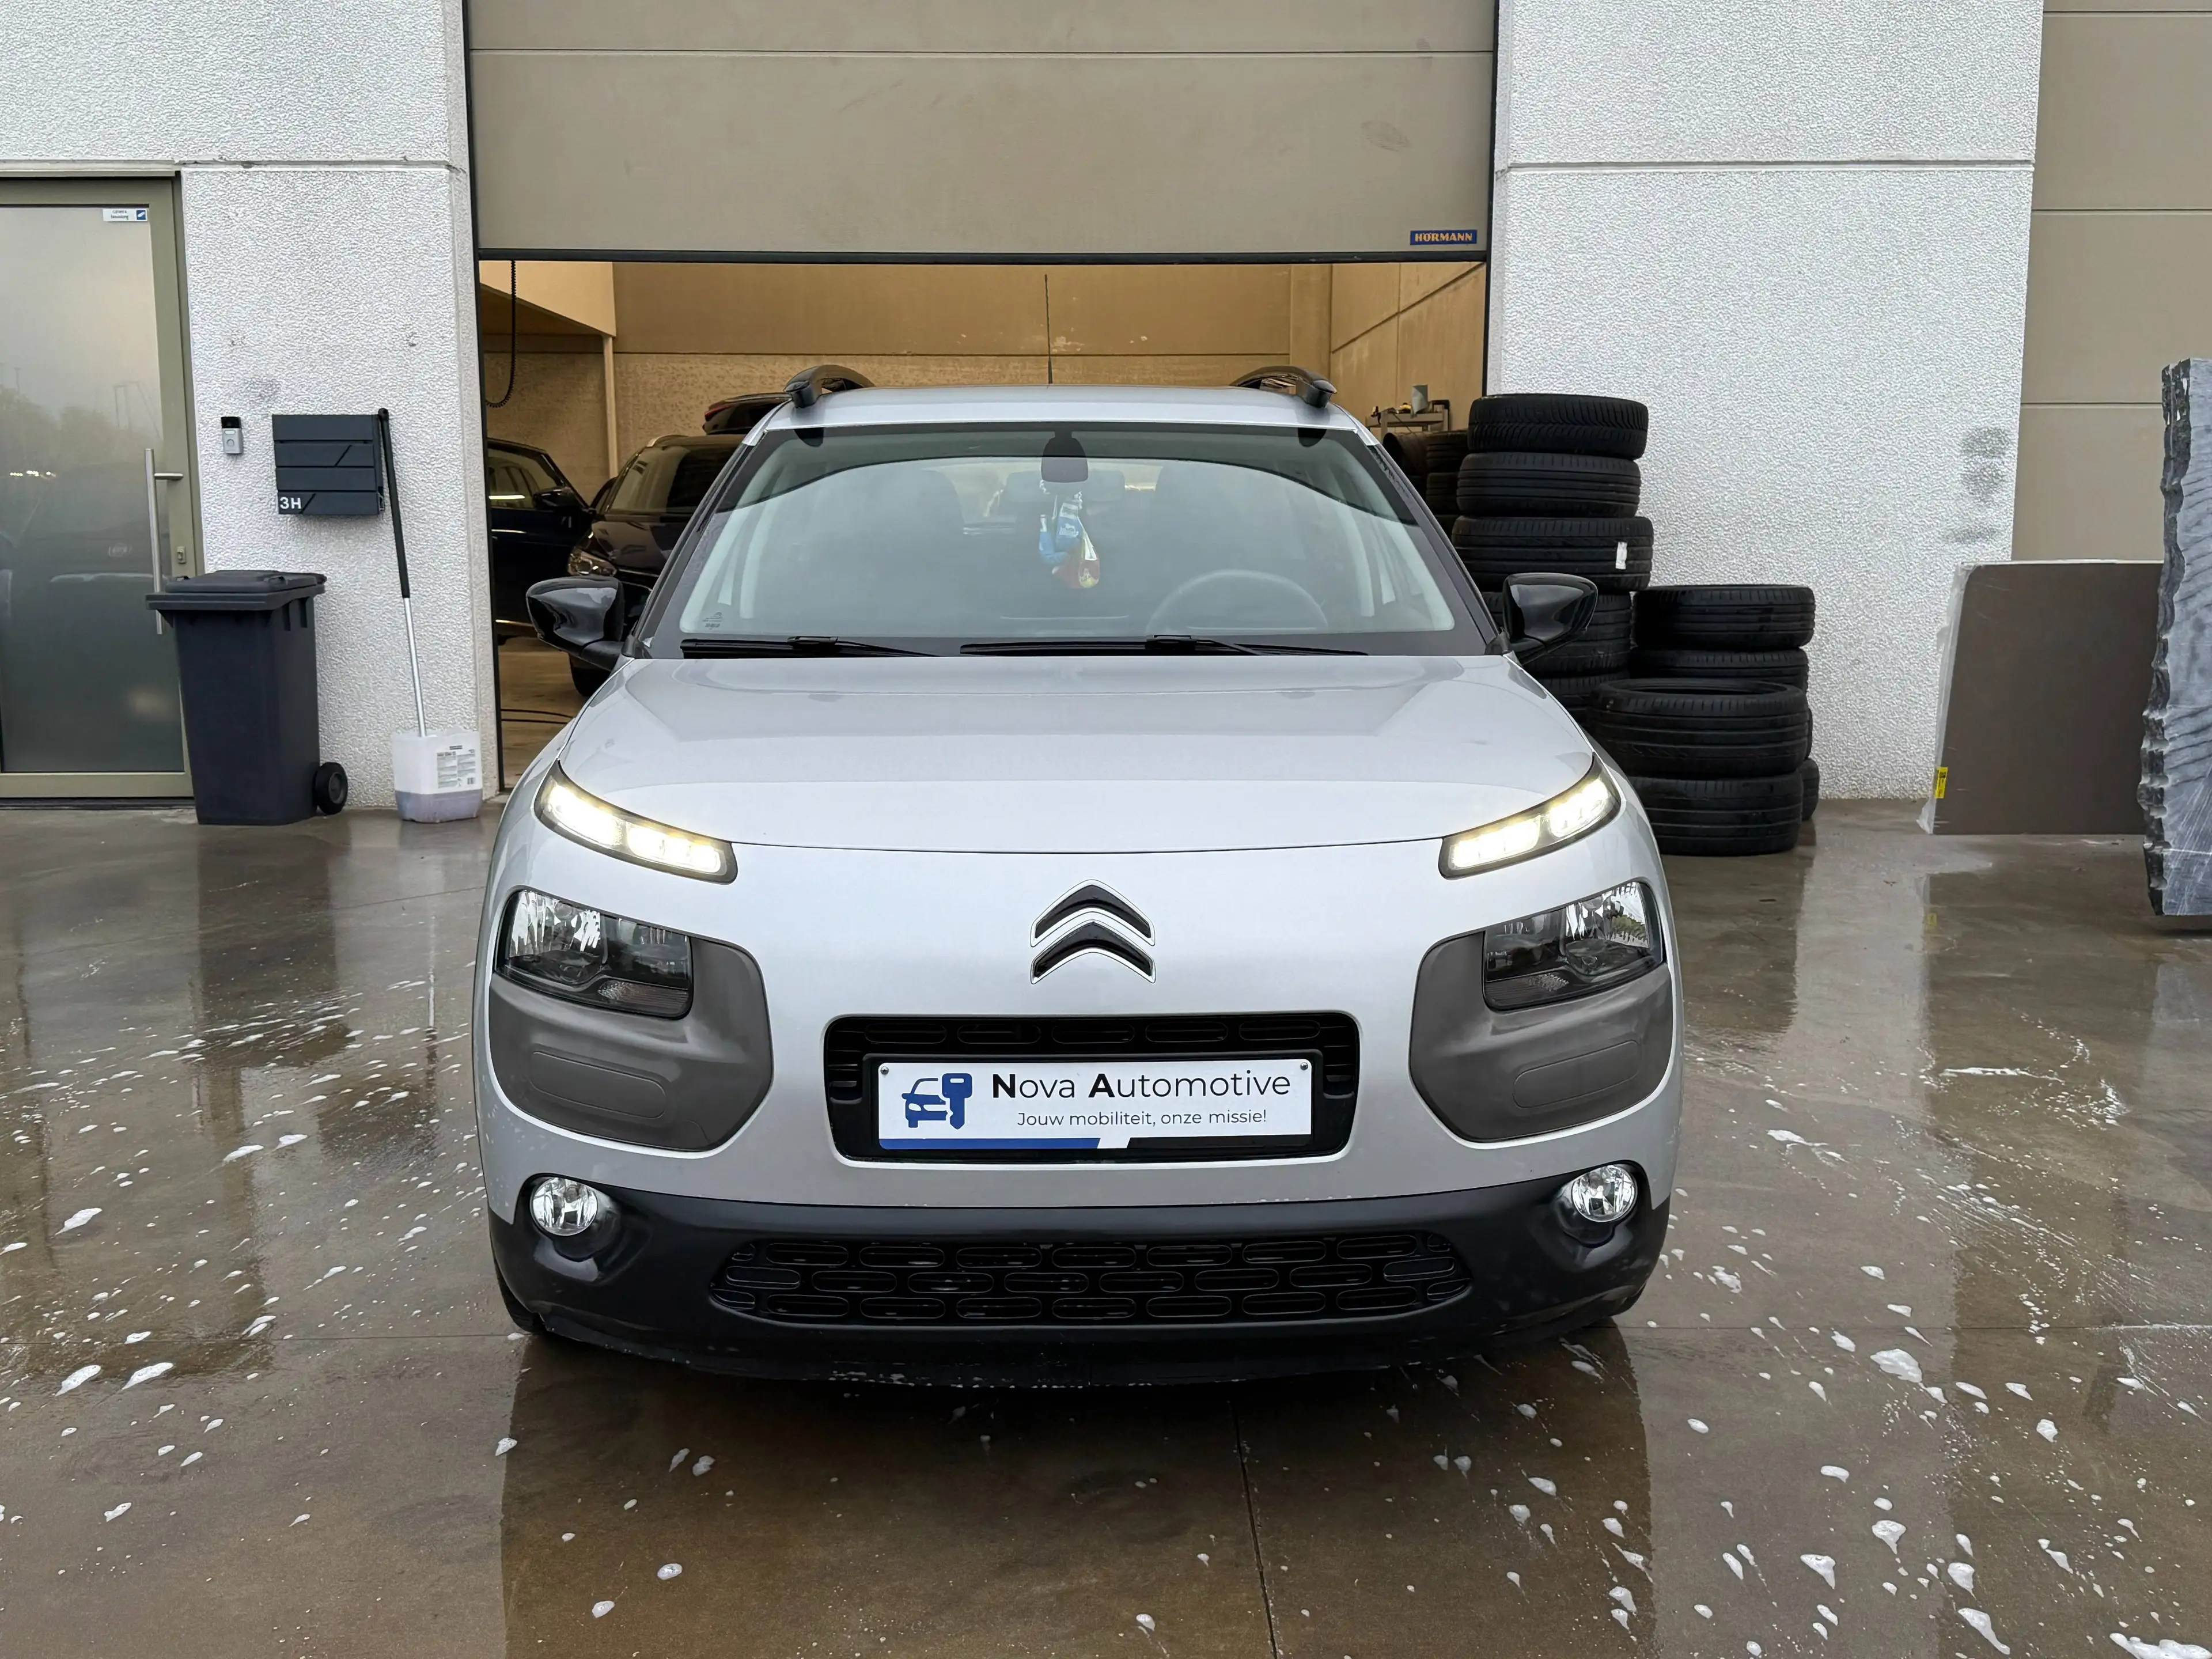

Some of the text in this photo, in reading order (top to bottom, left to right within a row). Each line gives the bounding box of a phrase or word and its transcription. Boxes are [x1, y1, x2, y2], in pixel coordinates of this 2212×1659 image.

[280, 497, 302, 509] 3H
[993, 1070, 1290, 1099] Nova Automotive
[1017, 1109, 1266, 1127] Jouw mobiliteit, onze missie!
